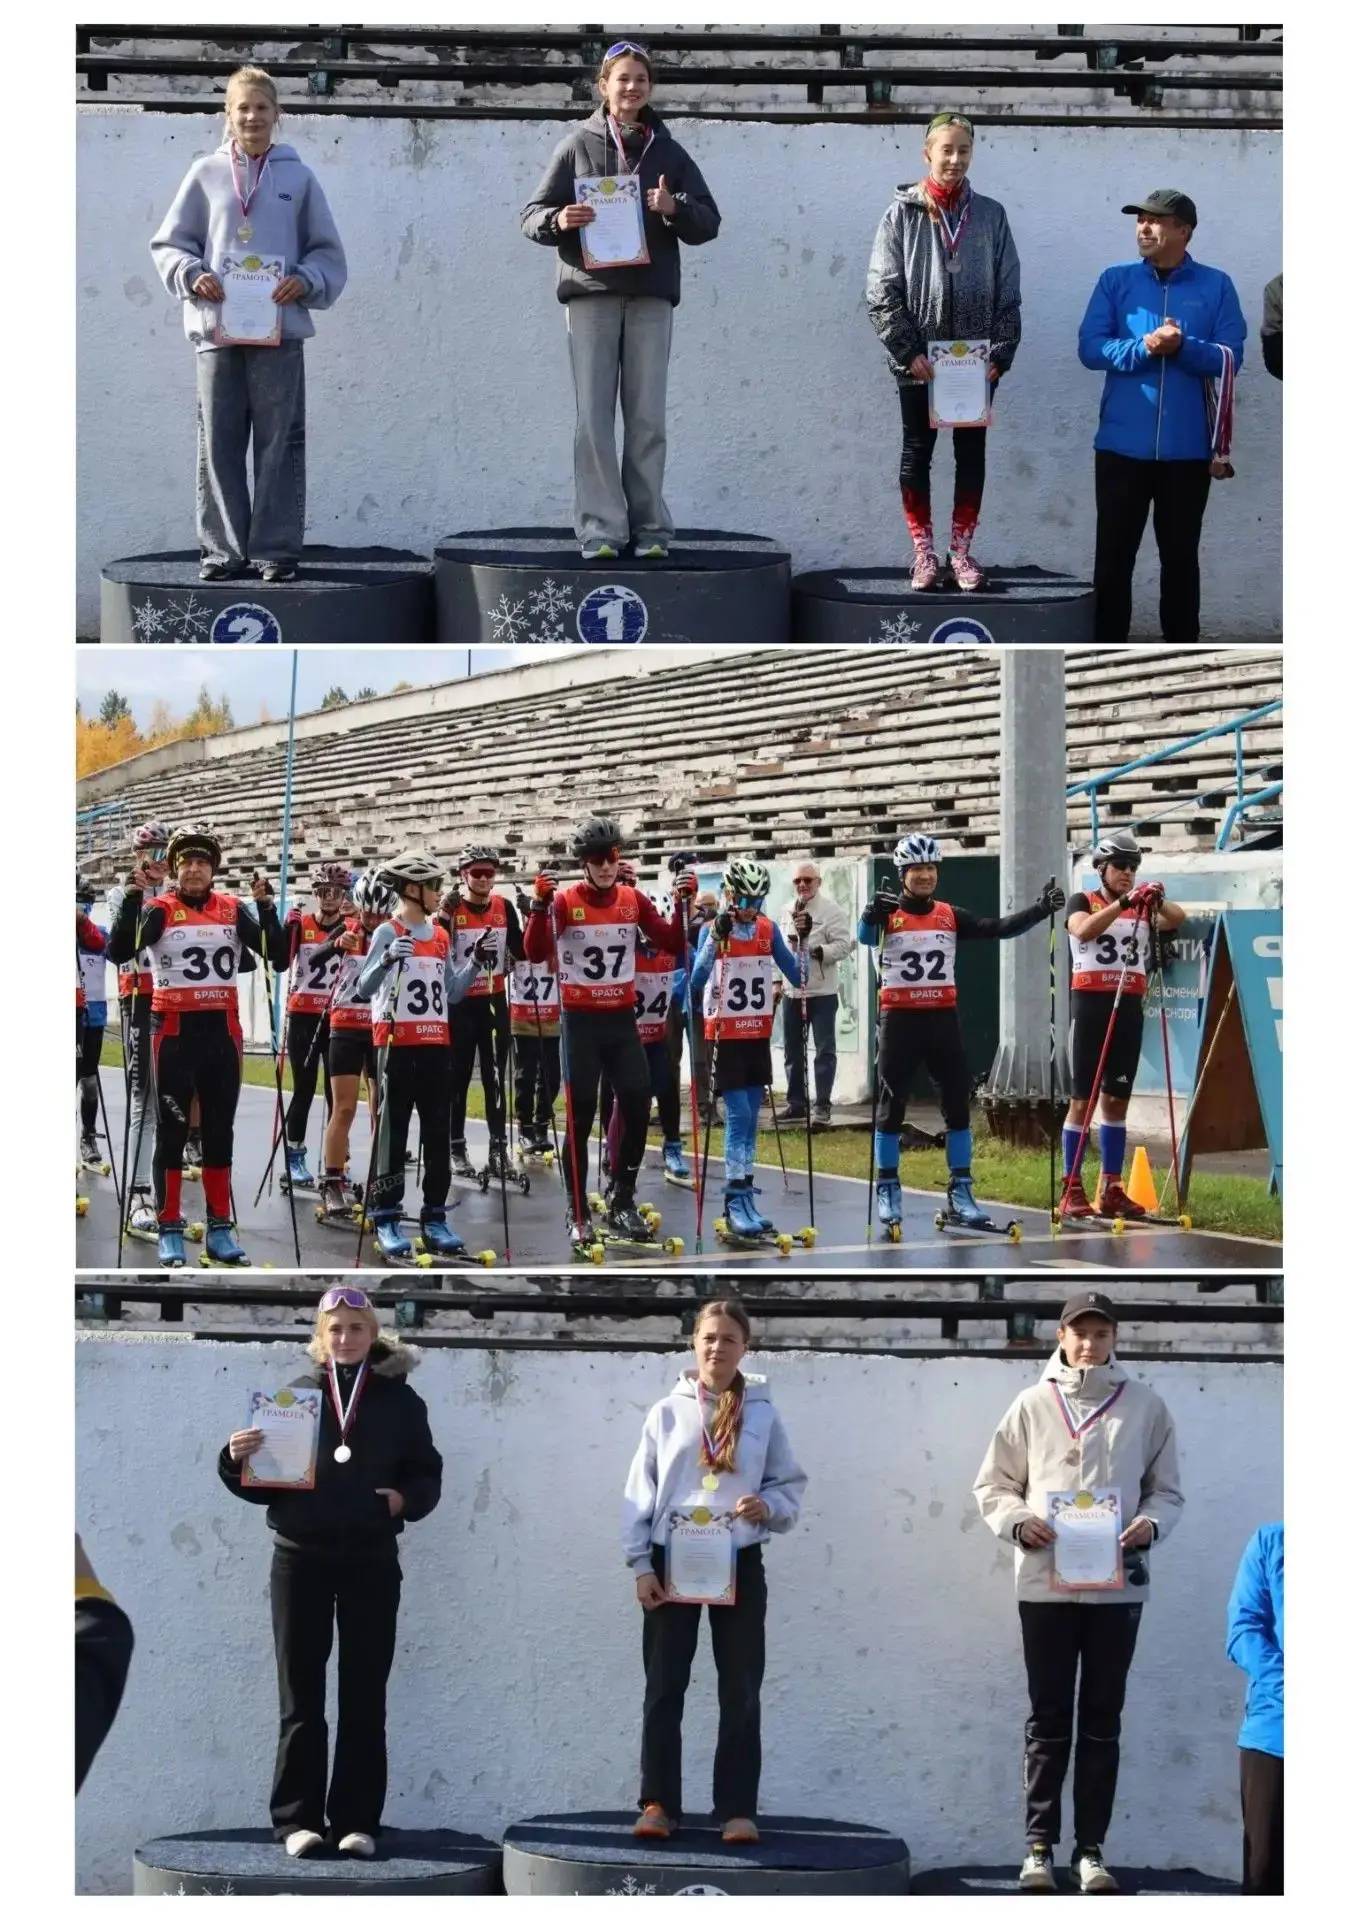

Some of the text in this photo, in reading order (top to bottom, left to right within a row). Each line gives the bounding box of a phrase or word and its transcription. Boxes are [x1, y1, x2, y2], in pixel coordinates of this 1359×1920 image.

[590, 197, 627, 205] ГРАМОТА
[231, 273, 271, 282] ГРАМОТА
[941, 359, 977, 367] ГРАМОТА
[598, 598, 623, 640] 1
[1095, 934, 1139, 966] 33
[182, 946, 235, 981] 30
[583, 945, 627, 980] 37
[900, 950, 946, 981] 32
[1101, 973, 1136, 983] БРАСК
[523, 976, 554, 1001] 27
[591, 988, 624, 998] БРАТСК
[194, 991, 229, 999] БРАТСК
[407, 979, 443, 1016] 38
[727, 977, 765, 1011] 35
[910, 990, 943, 998] БРАТСК
[416, 1025, 444, 1034] БРАТС
[735, 1020, 763, 1029] БРАТСК
[640, 1027, 659, 1035] АТСК
[262, 1409, 305, 1419] ГРАМОТА
[680, 1528, 722, 1536] ГРАМОТА
